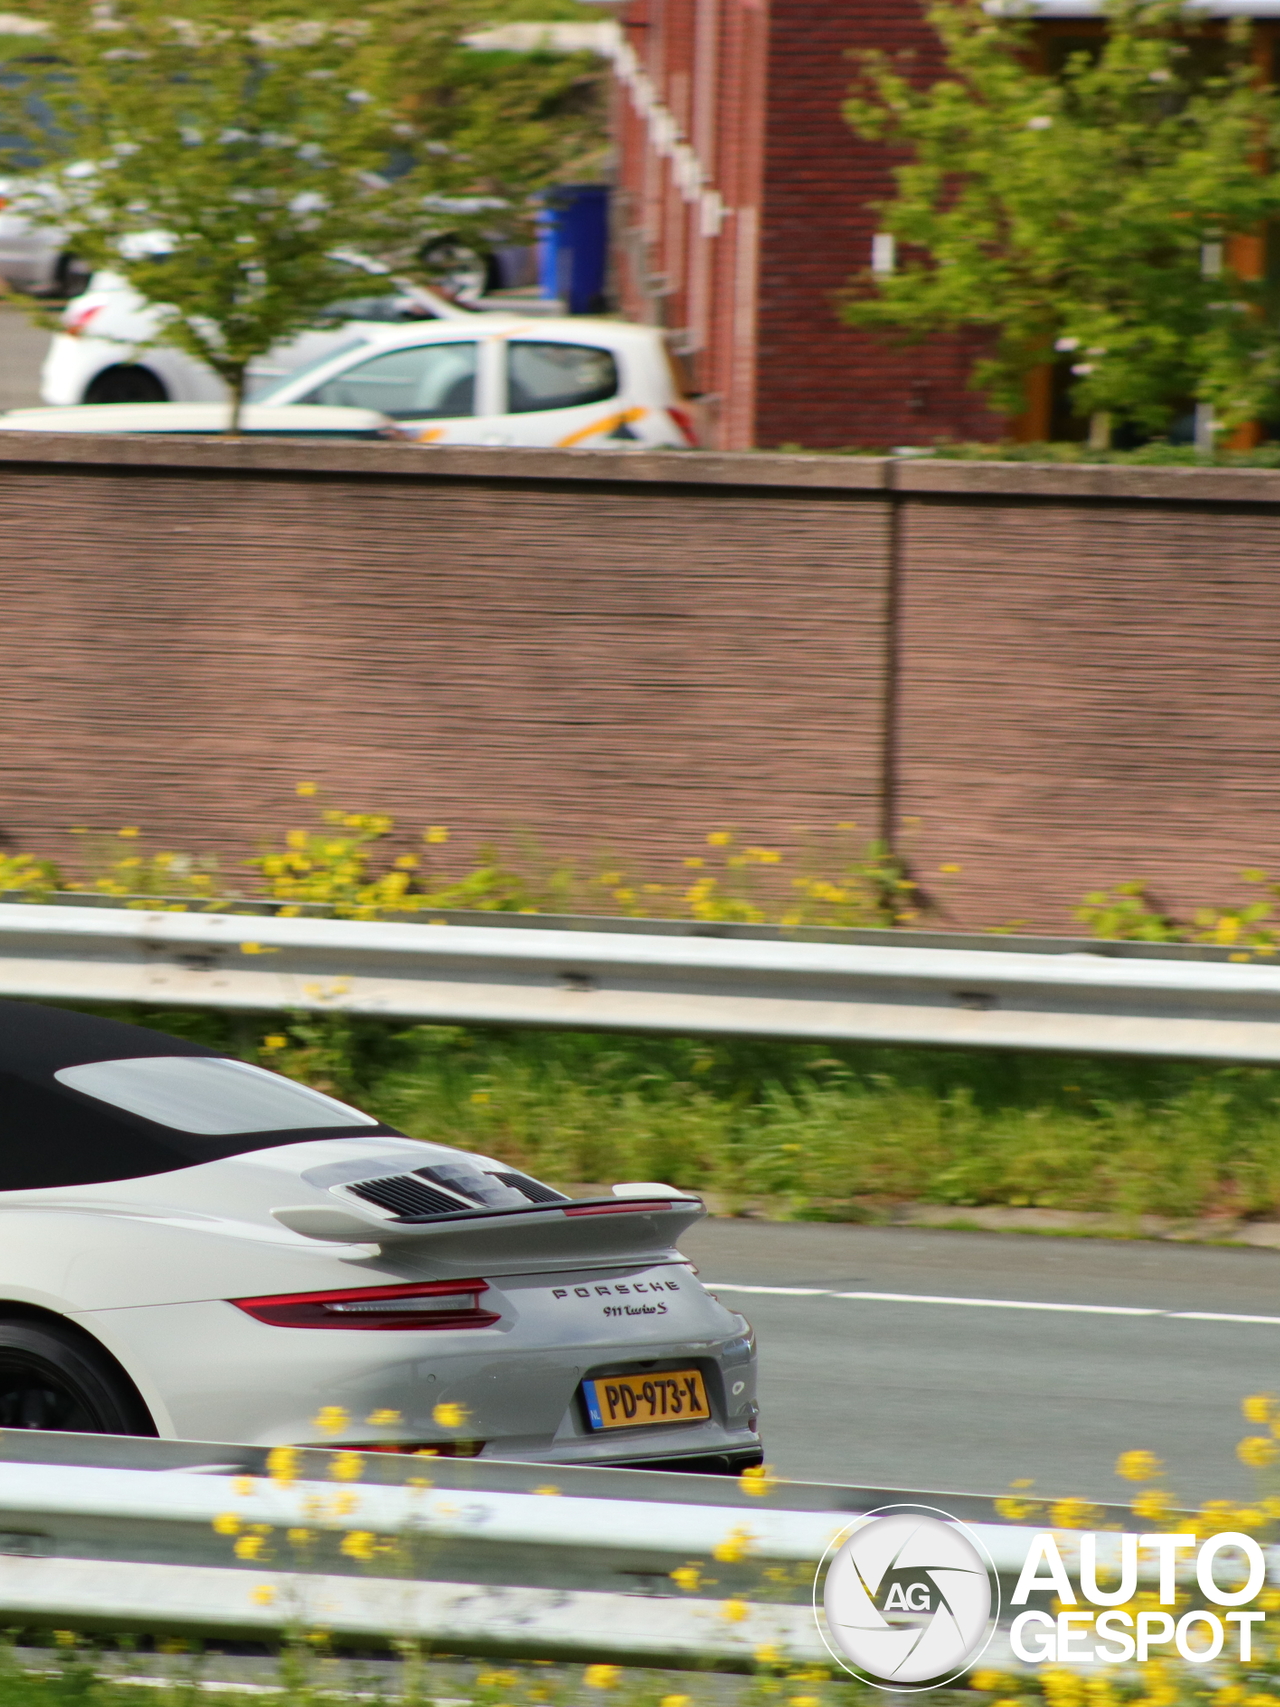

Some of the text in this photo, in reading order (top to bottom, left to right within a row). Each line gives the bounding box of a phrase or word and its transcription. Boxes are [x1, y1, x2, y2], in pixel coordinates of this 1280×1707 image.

[552, 1281, 680, 1299] PORSCHE
[603, 1302, 668, 1317] 911 Turbo S
[590, 1377, 702, 1421] NL PD-973-X
